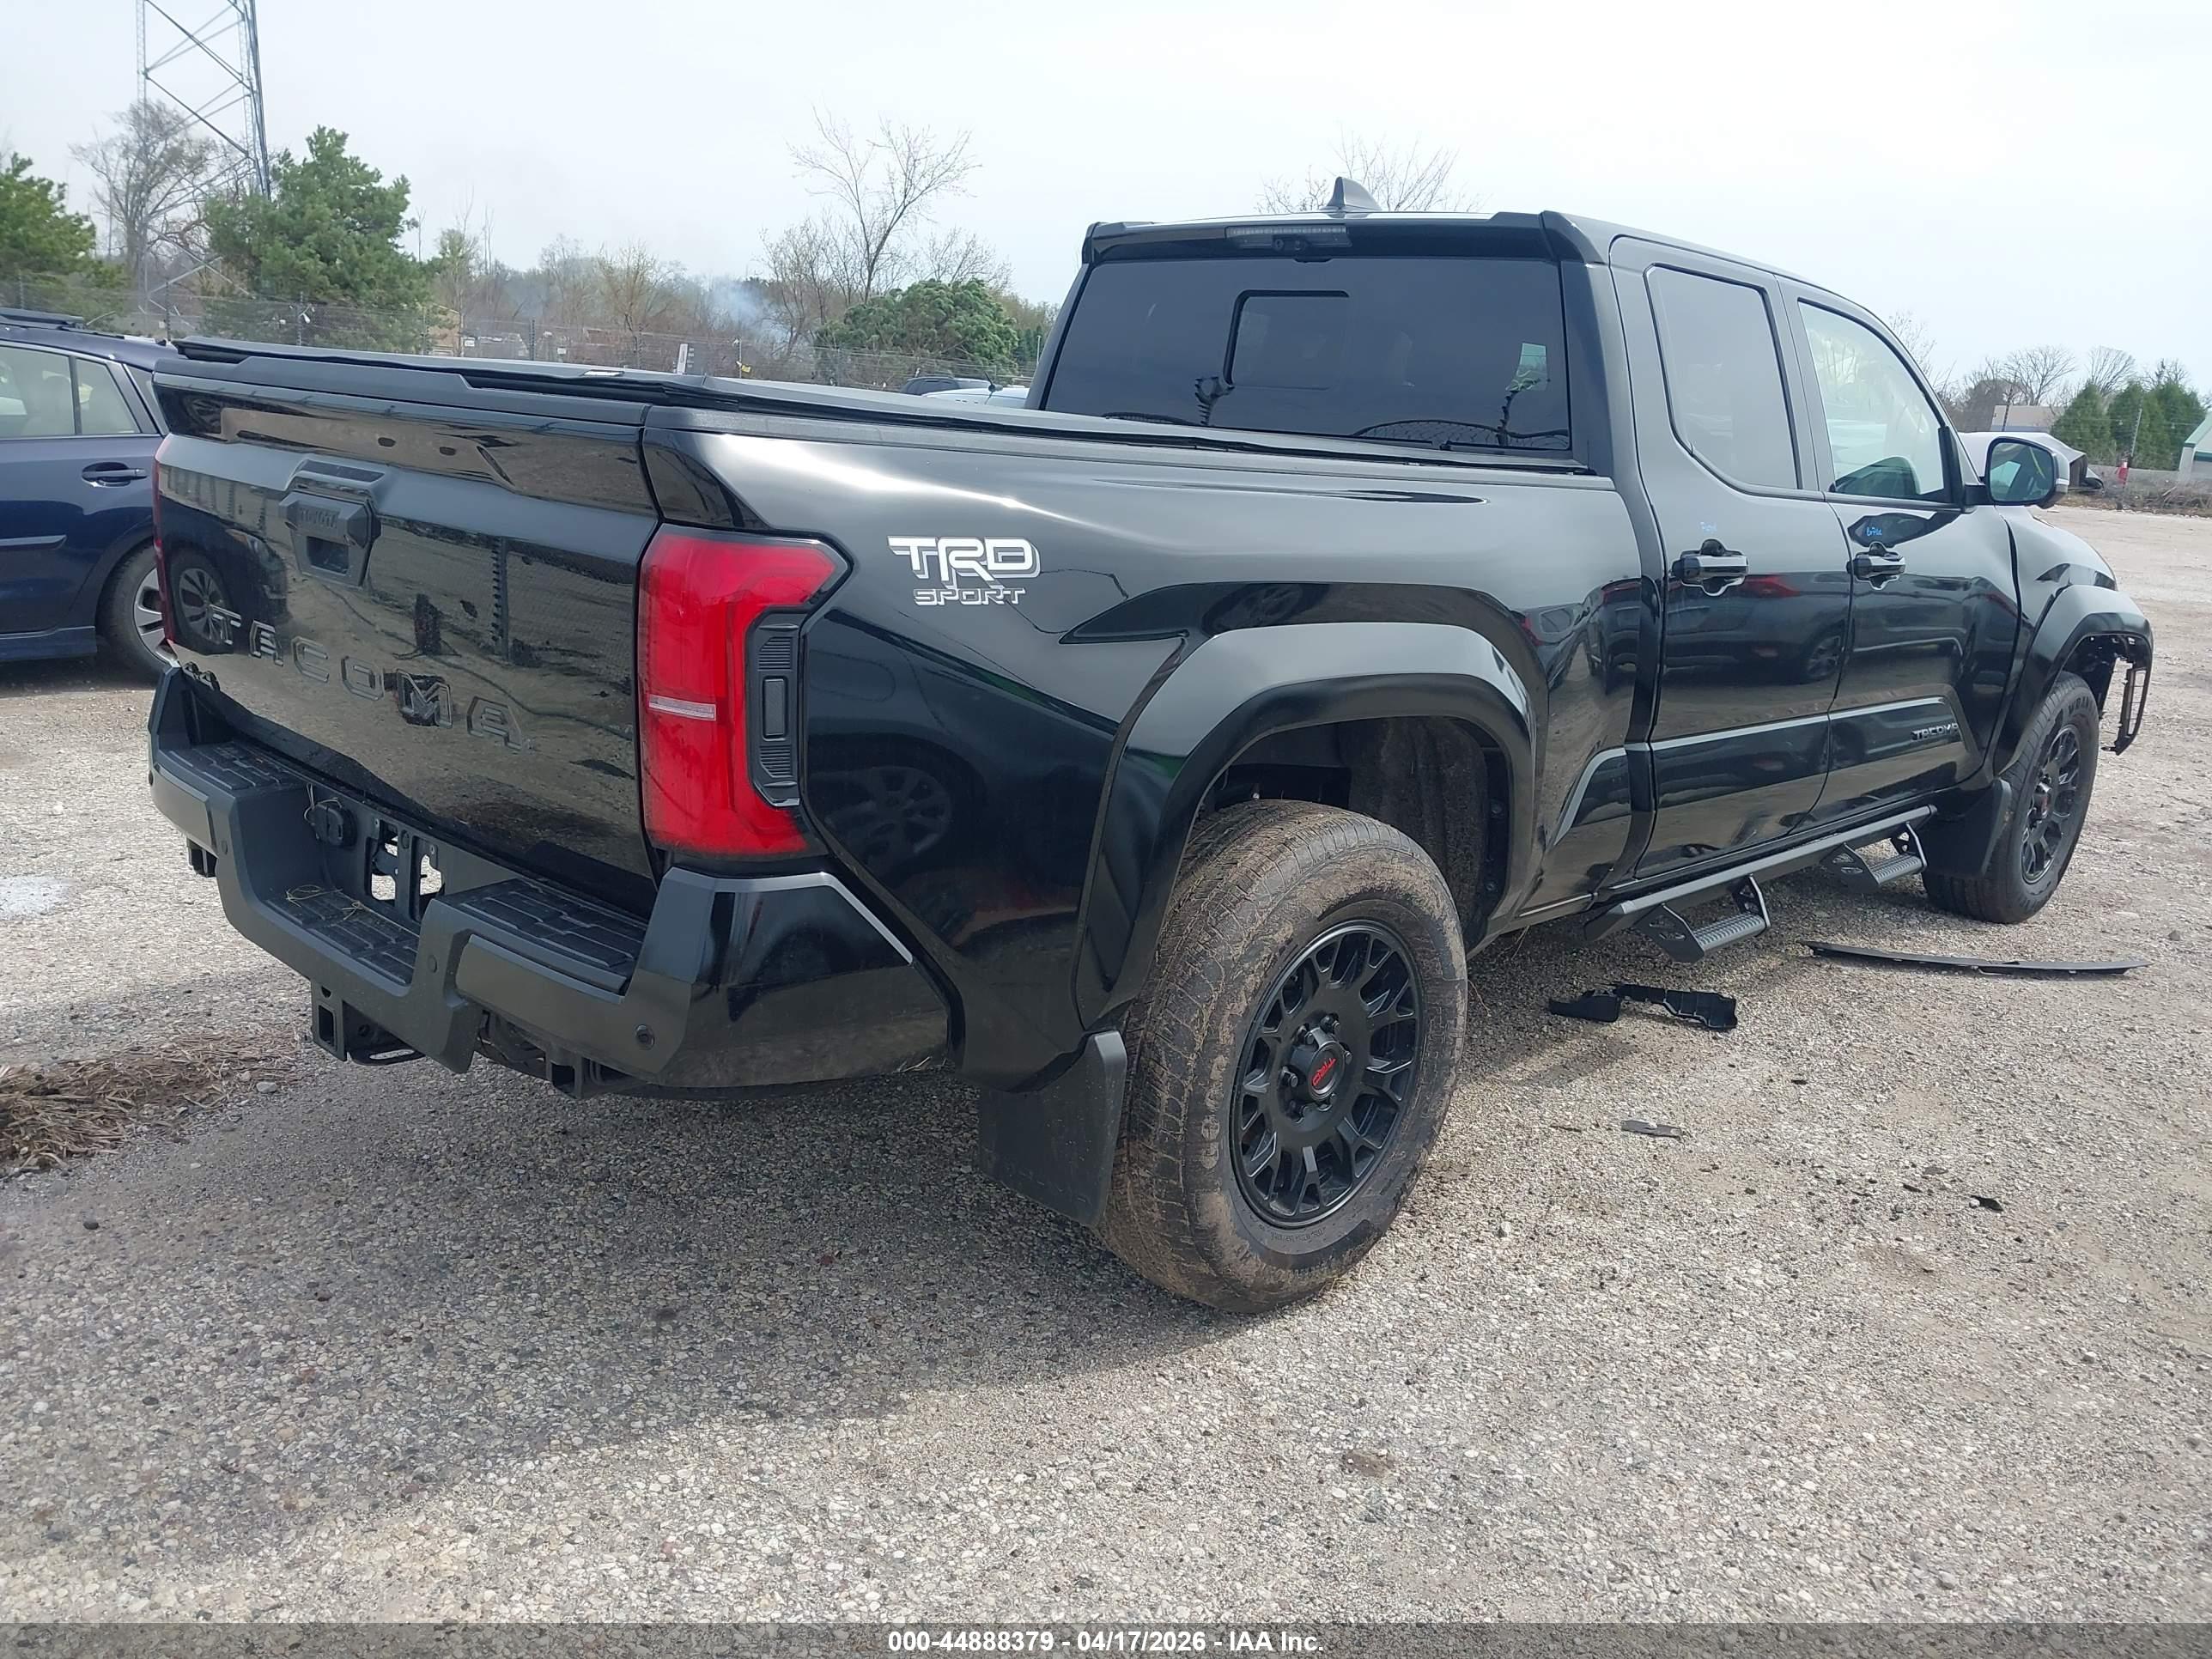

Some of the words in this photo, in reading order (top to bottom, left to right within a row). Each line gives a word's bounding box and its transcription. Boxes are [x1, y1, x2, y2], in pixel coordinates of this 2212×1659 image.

[887, 536, 1041, 589] TRD
[913, 588, 1026, 605] SPORT
[208, 604, 525, 753] TACOMA
